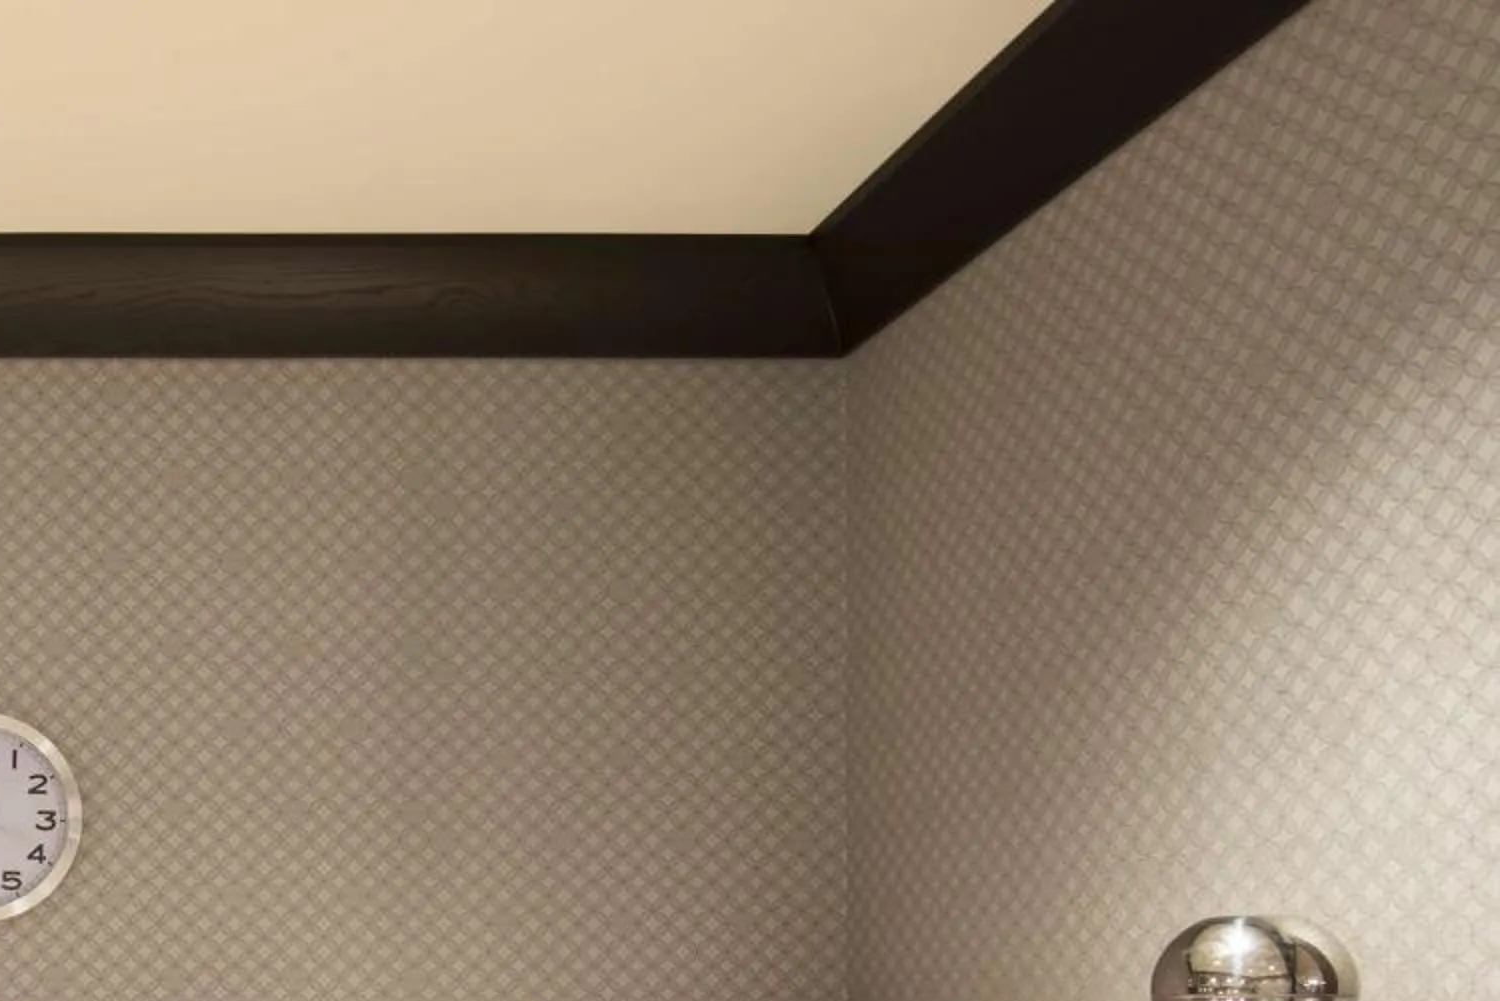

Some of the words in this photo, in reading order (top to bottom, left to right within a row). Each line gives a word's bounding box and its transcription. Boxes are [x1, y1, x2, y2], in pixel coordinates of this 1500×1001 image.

[12, 749, 18, 769] 1
[28, 774, 48, 795] 2
[35, 810, 57, 831] 3
[27, 844, 47, 864] 4
[2, 871, 22, 891] 5
